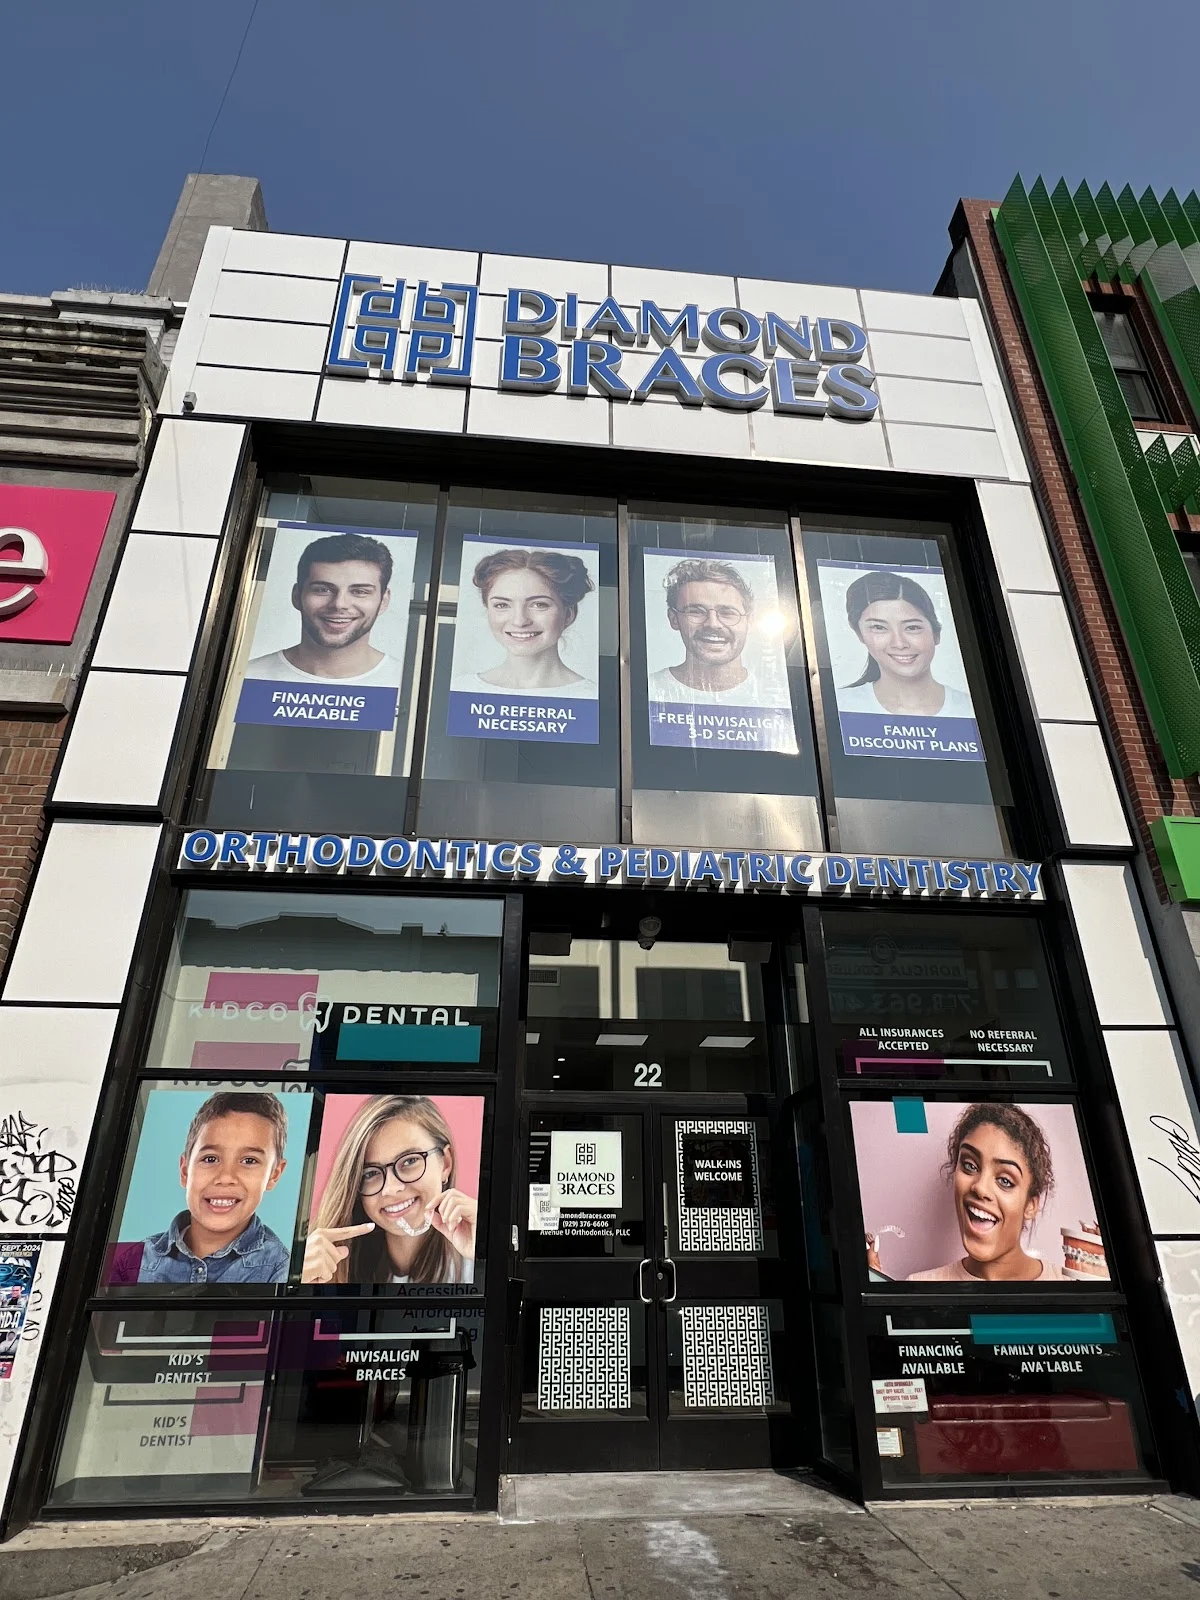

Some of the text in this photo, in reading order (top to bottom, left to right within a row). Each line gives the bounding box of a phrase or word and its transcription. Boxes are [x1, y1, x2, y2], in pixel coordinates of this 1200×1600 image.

[505, 288, 868, 360] DIAMOND
[501, 335, 880, 418] BRACES
[272, 691, 366, 708] FINANCING
[470, 703, 576, 720] NO REFERRAL
[478, 718, 567, 733] NECESSARY
[658, 712, 784, 730] FREE INVISALIGN
[688, 728, 758, 742] 3-D SCAN
[883, 725, 937, 738] FAMILY
[848, 736, 978, 753] DISCOUNT PLANS
[183, 830, 1042, 893] ORTHODONTICS & PEDIATRIC DENTISTRY
[188, 1000, 470, 1027] KIDCO DENTAL
[859, 1027, 944, 1038] ALL INSURANCES
[970, 1030, 1038, 1040] NO REFERRAL
[878, 1041, 929, 1051] ACCEPTED
[977, 1042, 1034, 1053] NECESSARY
[633, 1062, 663, 1087] 22
[695, 1159, 742, 1169] WALK-INS
[557, 1172, 615, 1182] DIAMOND
[694, 1171, 742, 1181] WELCOME
[562, 1220, 609, 1228] (929) 376-6606
[571, 1229, 614, 1237] Orthodontics,
[1, 1244, 41, 1252] SEPT. 2024
[397, 1284, 479, 1296] Accessible
[346, 1349, 420, 1363] INVISALIGN
[898, 1345, 963, 1357] FINANCING
[993, 1343, 1103, 1356] FAMILY DISCOUNTS
[168, 1353, 205, 1366] KID'S
[902, 1362, 966, 1374] AVAILABLE
[1021, 1361, 1083, 1373] AVALABLE
[154, 1372, 212, 1384] DENTIST
[356, 1368, 406, 1381] BRACES
[140, 1434, 195, 1447] DENTIST
